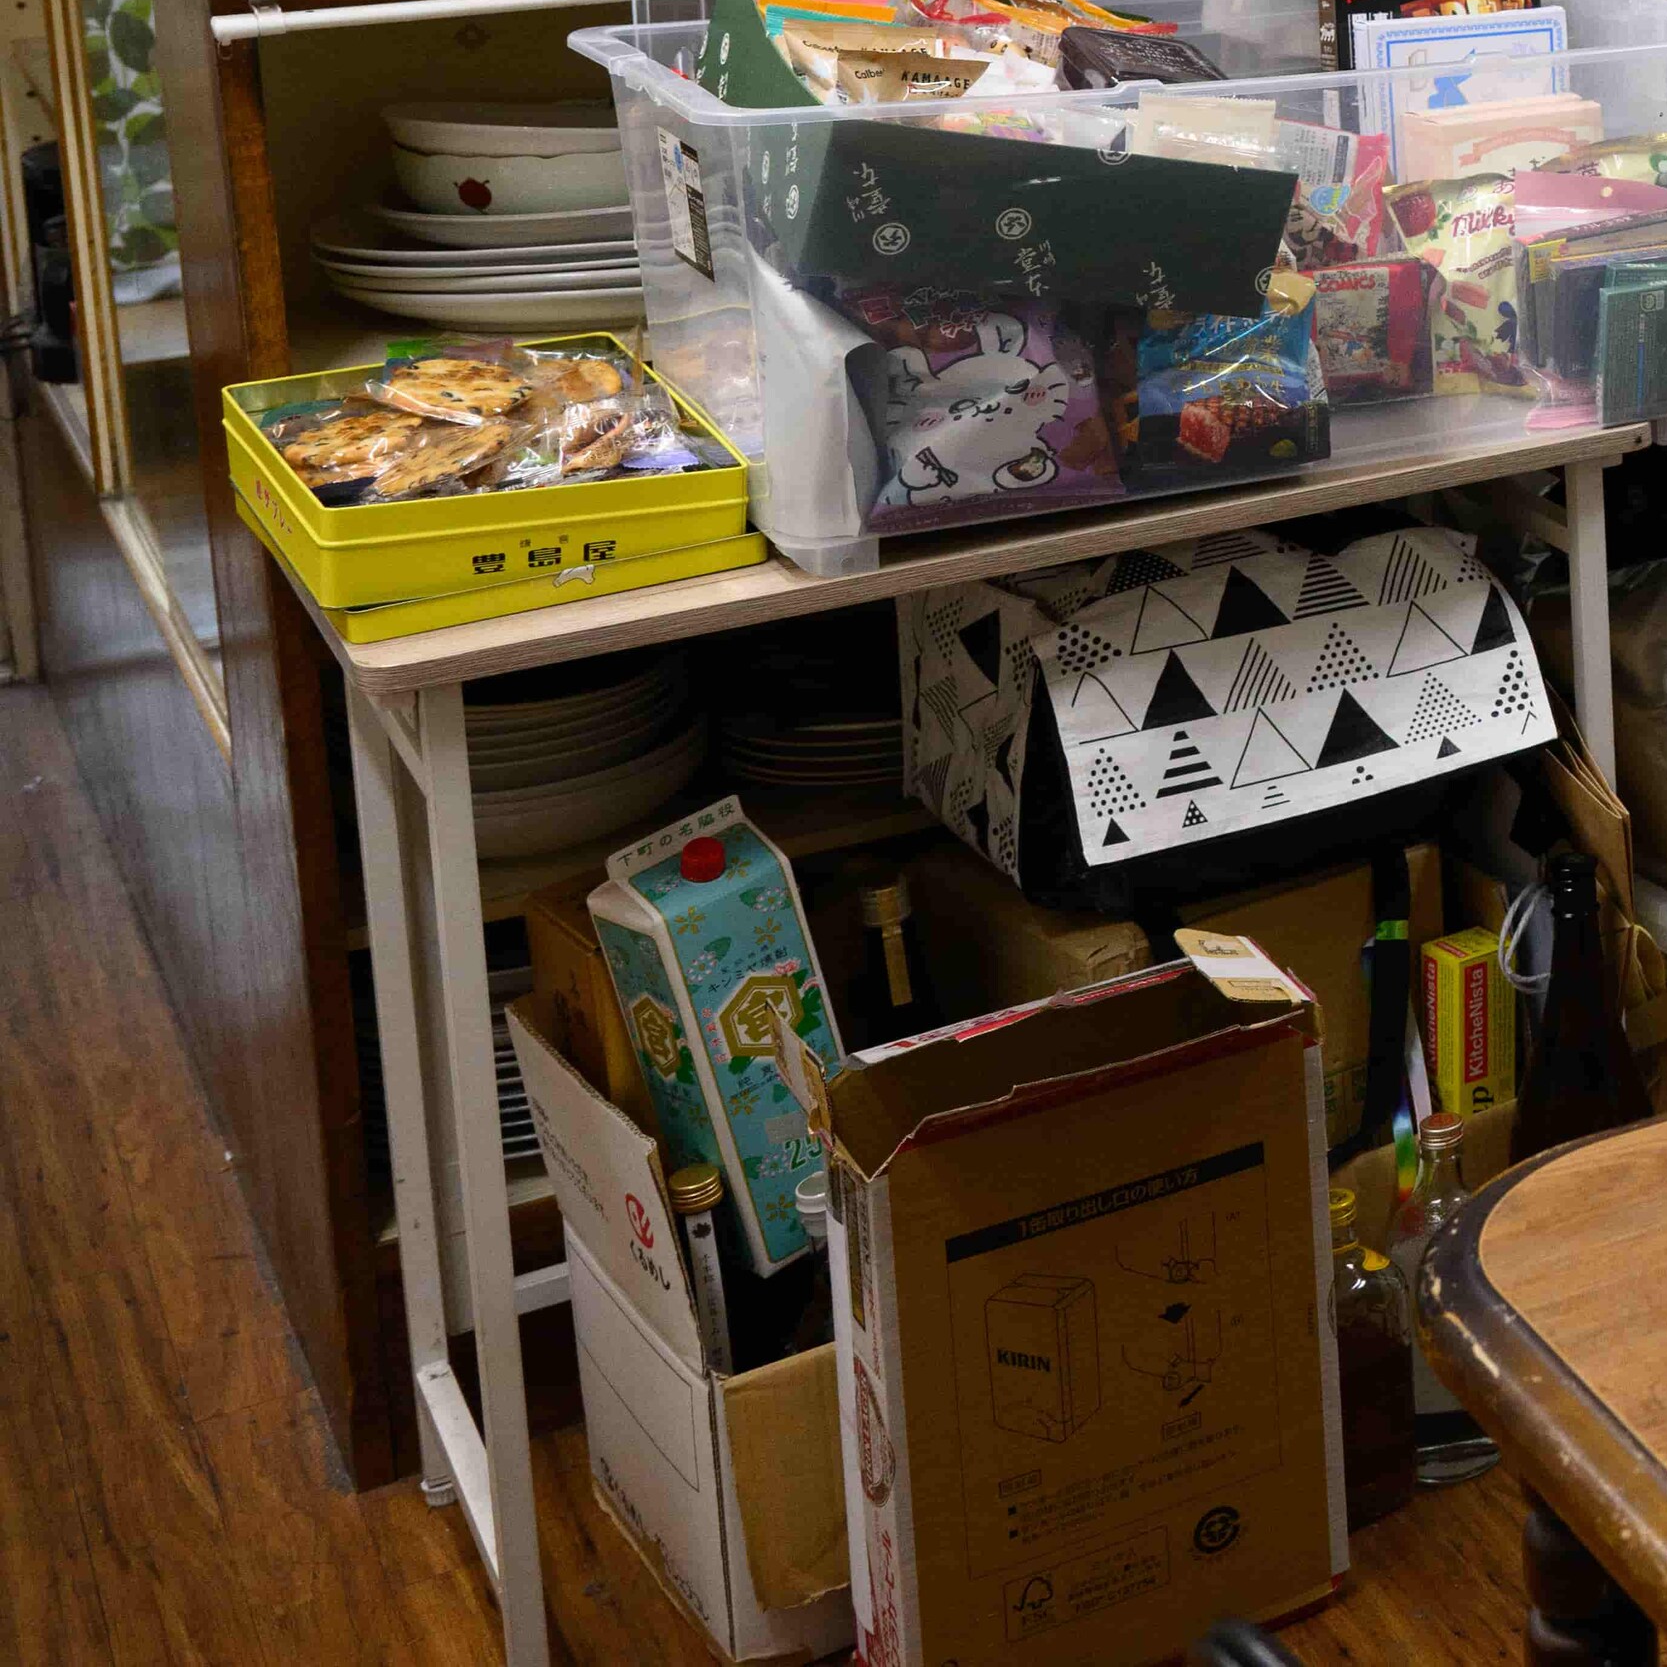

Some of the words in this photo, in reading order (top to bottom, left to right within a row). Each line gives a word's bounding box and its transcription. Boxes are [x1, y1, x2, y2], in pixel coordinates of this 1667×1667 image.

[1319, 274, 1377, 293] COMICS
[471, 539, 618, 576] 豊島屋
[617, 801, 736, 868] 下町の名脇役
[707, 945, 790, 994] キンミヤ焼酎
[1468, 967, 1485, 1078] KitcheNista
[1017, 1166, 1200, 1239] 1缶取り出し口の使い方
[997, 1347, 1051, 1374] KIRIN
